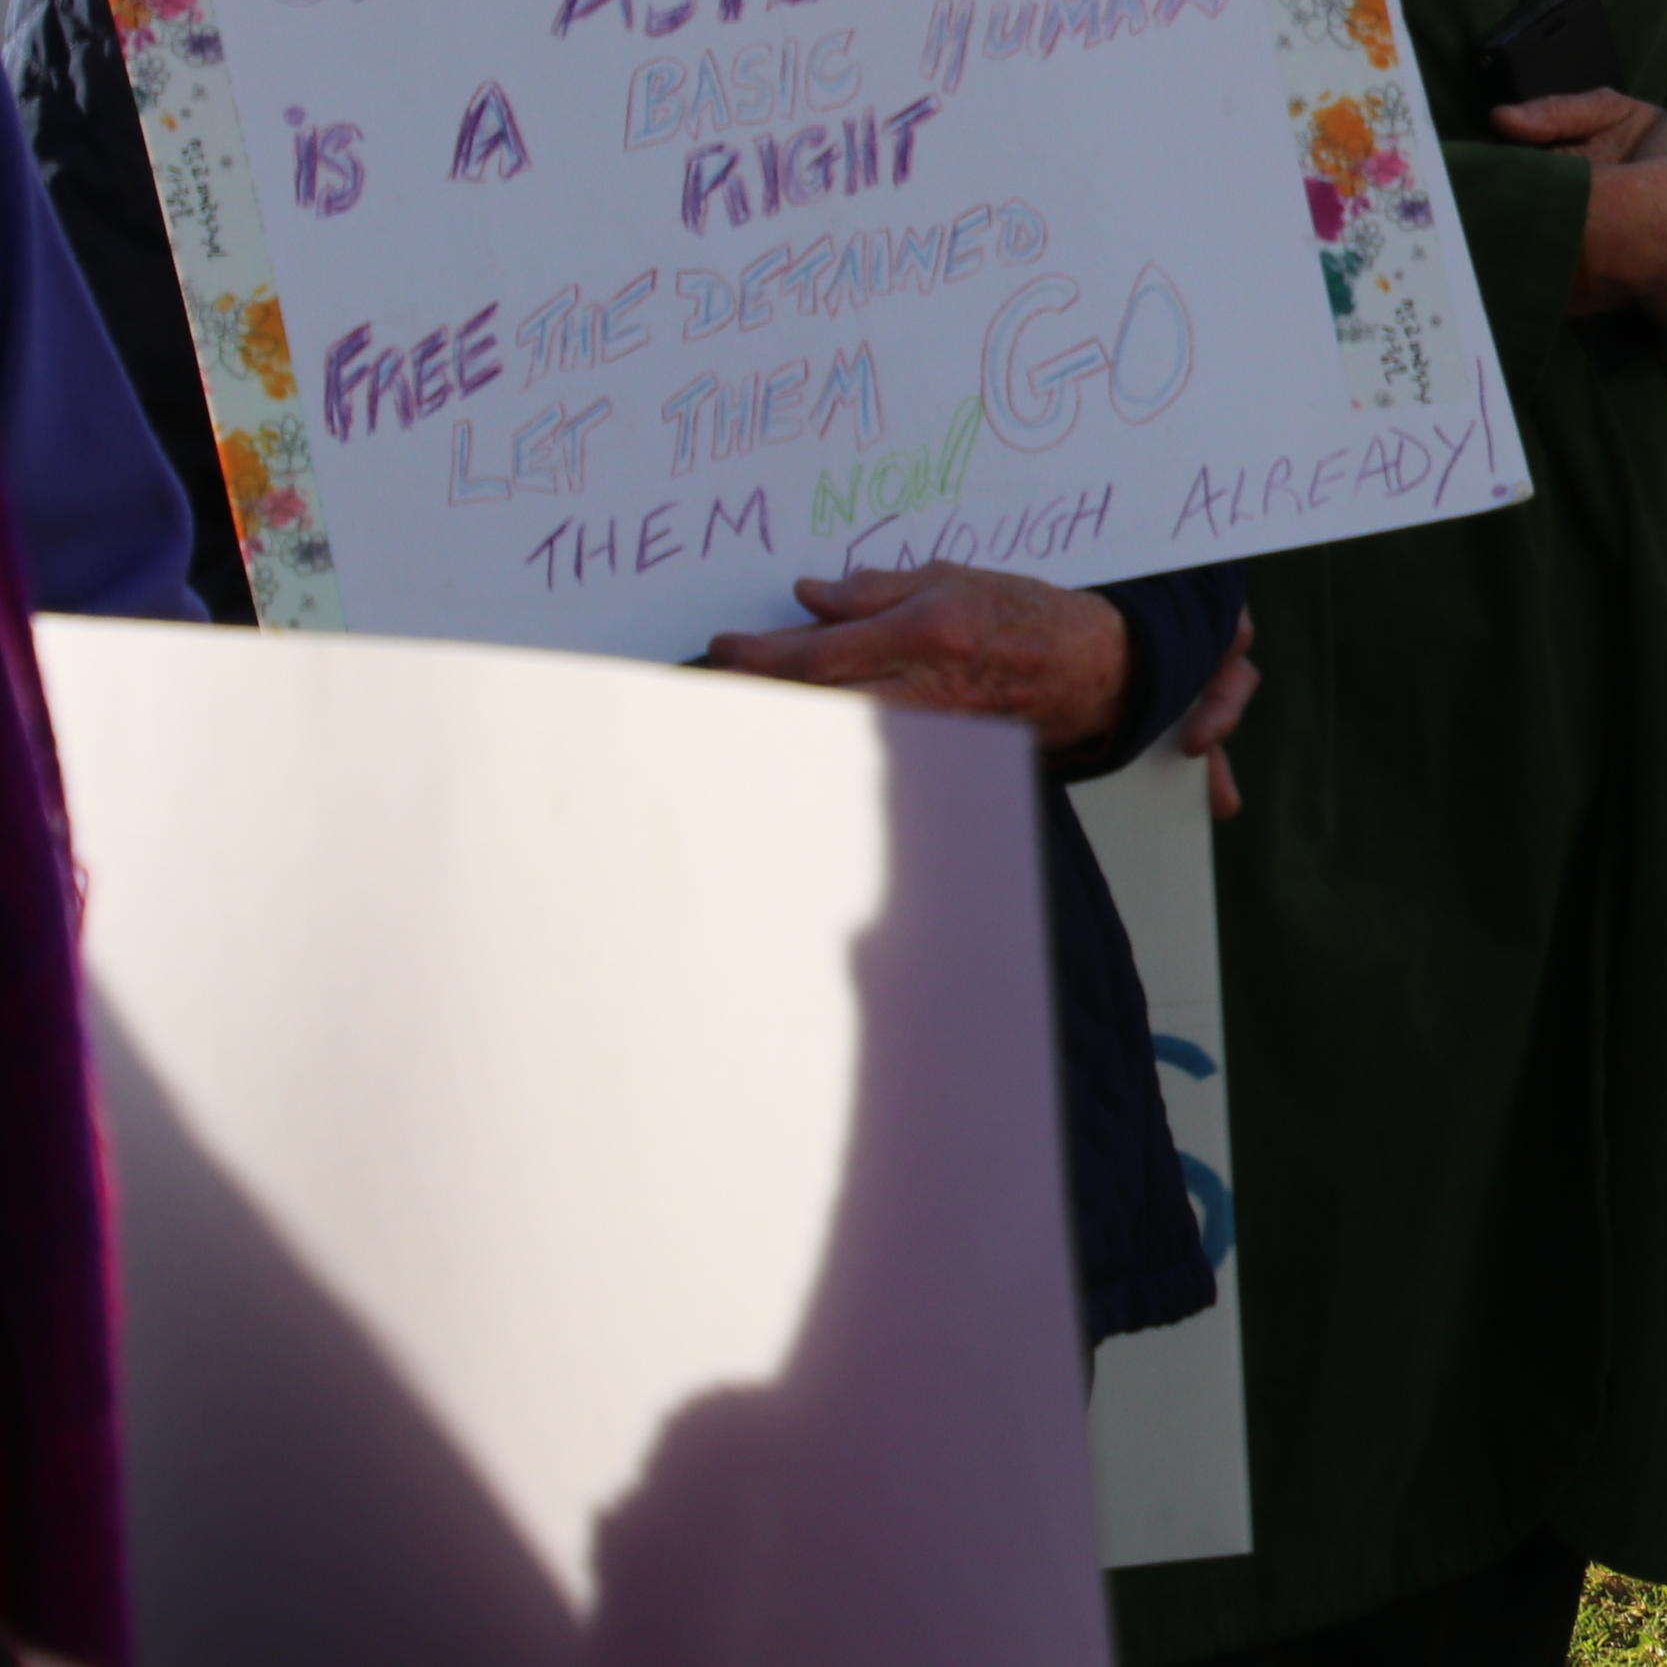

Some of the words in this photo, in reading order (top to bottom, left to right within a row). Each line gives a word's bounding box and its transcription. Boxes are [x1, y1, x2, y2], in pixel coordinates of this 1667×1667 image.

[446, 79, 532, 184] A
[625, 29, 862, 151] BASIC
[681, 93, 941, 235] RIGHT
[324, 301, 501, 443] FREE
[517, 267, 657, 392] THE
[676, 199, 1046, 341] DETAINED
[448, 398, 612, 507] LET
[662, 339, 884, 478] THEM
[981, 262, 1195, 453] GO
[525, 486, 773, 590] THEM
[811, 395, 983, 538] NOW
[1171, 356, 1508, 539] ALREADY!
